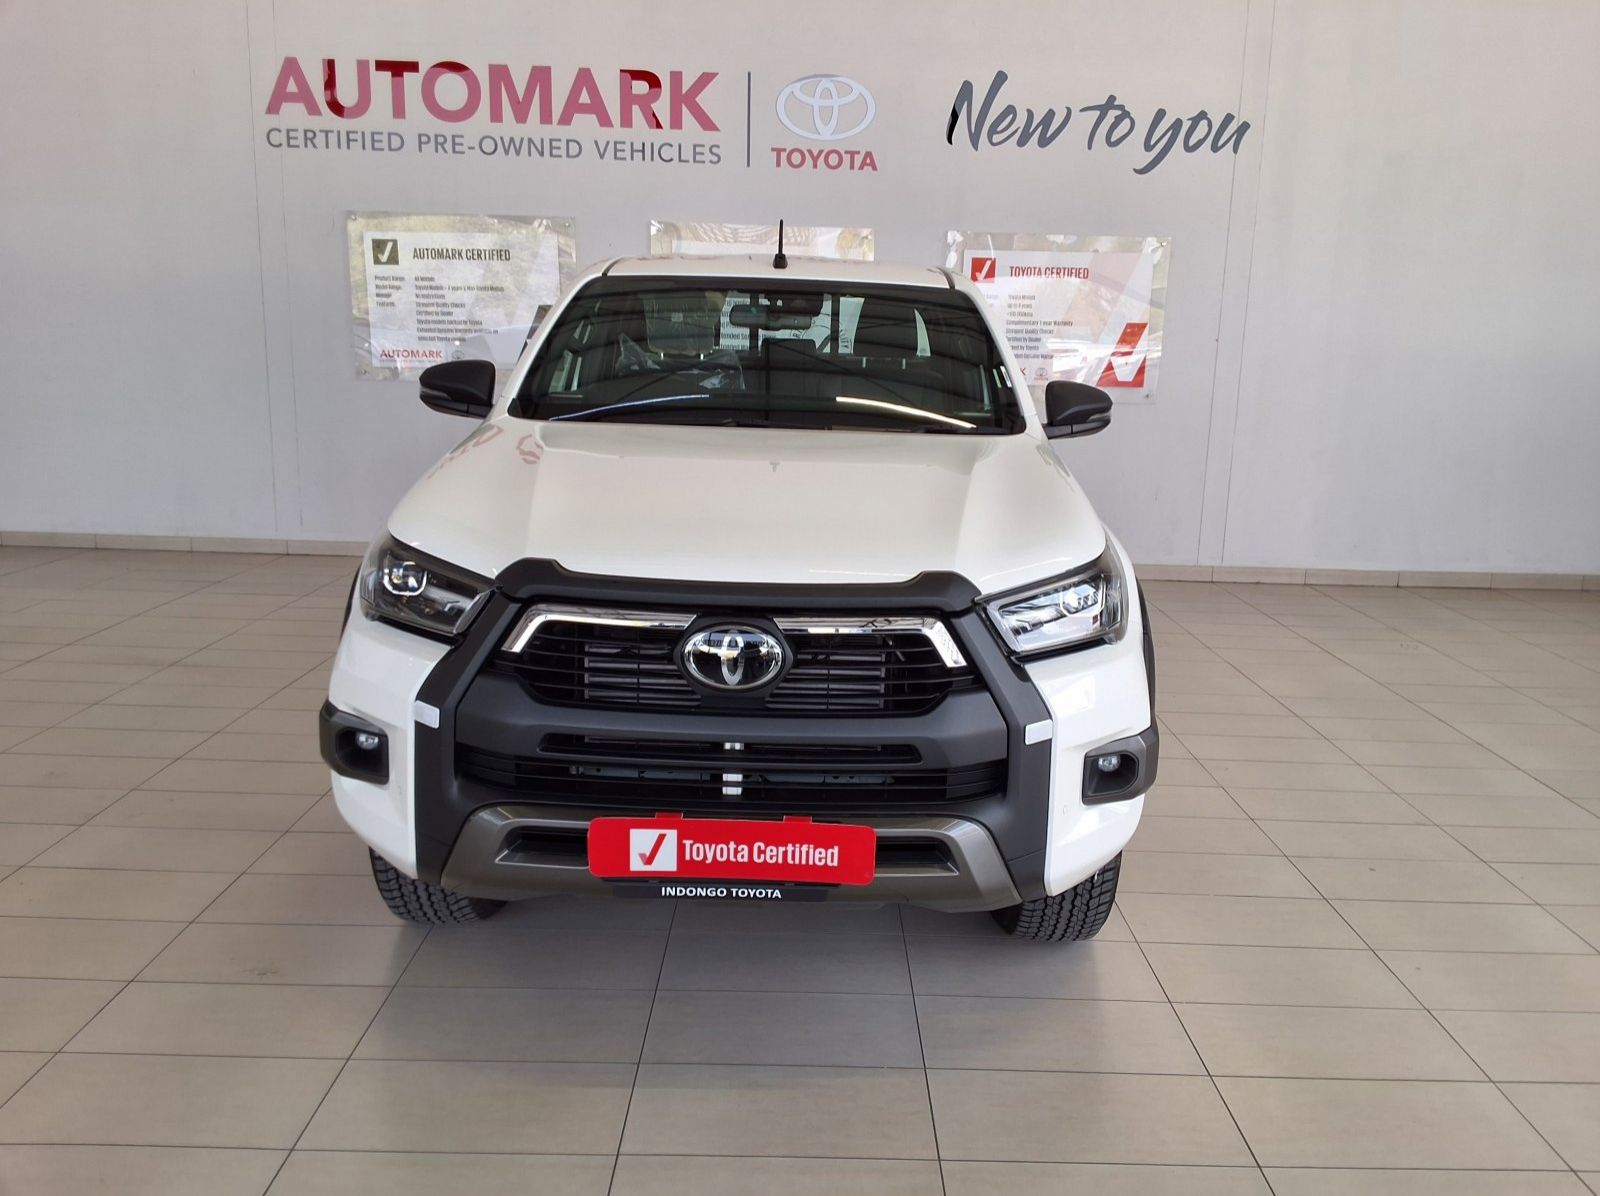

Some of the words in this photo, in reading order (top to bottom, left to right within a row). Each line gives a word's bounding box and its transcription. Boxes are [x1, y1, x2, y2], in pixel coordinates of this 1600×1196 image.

[265, 56, 721, 132] AUTOMARK
[946, 70, 1072, 151] New
[1079, 94, 1136, 151] to
[1133, 108, 1250, 175] you
[265, 127, 405, 153] CERTIFIED
[417, 132, 583, 159] PRE-OWNED
[596, 139, 722, 165] VEHICLES
[771, 147, 878, 171] TOYOTA
[413, 247, 463, 261] AUTOMARK
[465, 248, 511, 262] CERTIFIED
[1009, 266, 1042, 278] TOYOTA
[1044, 266, 1089, 280] CERTIFIED
[380, 350, 443, 359] AUTOMARK
[683, 839, 748, 864] Toyota
[753, 841, 839, 867] Certified
[661, 886, 727, 898] INDONGO
[730, 887, 782, 899] TOYOTA
